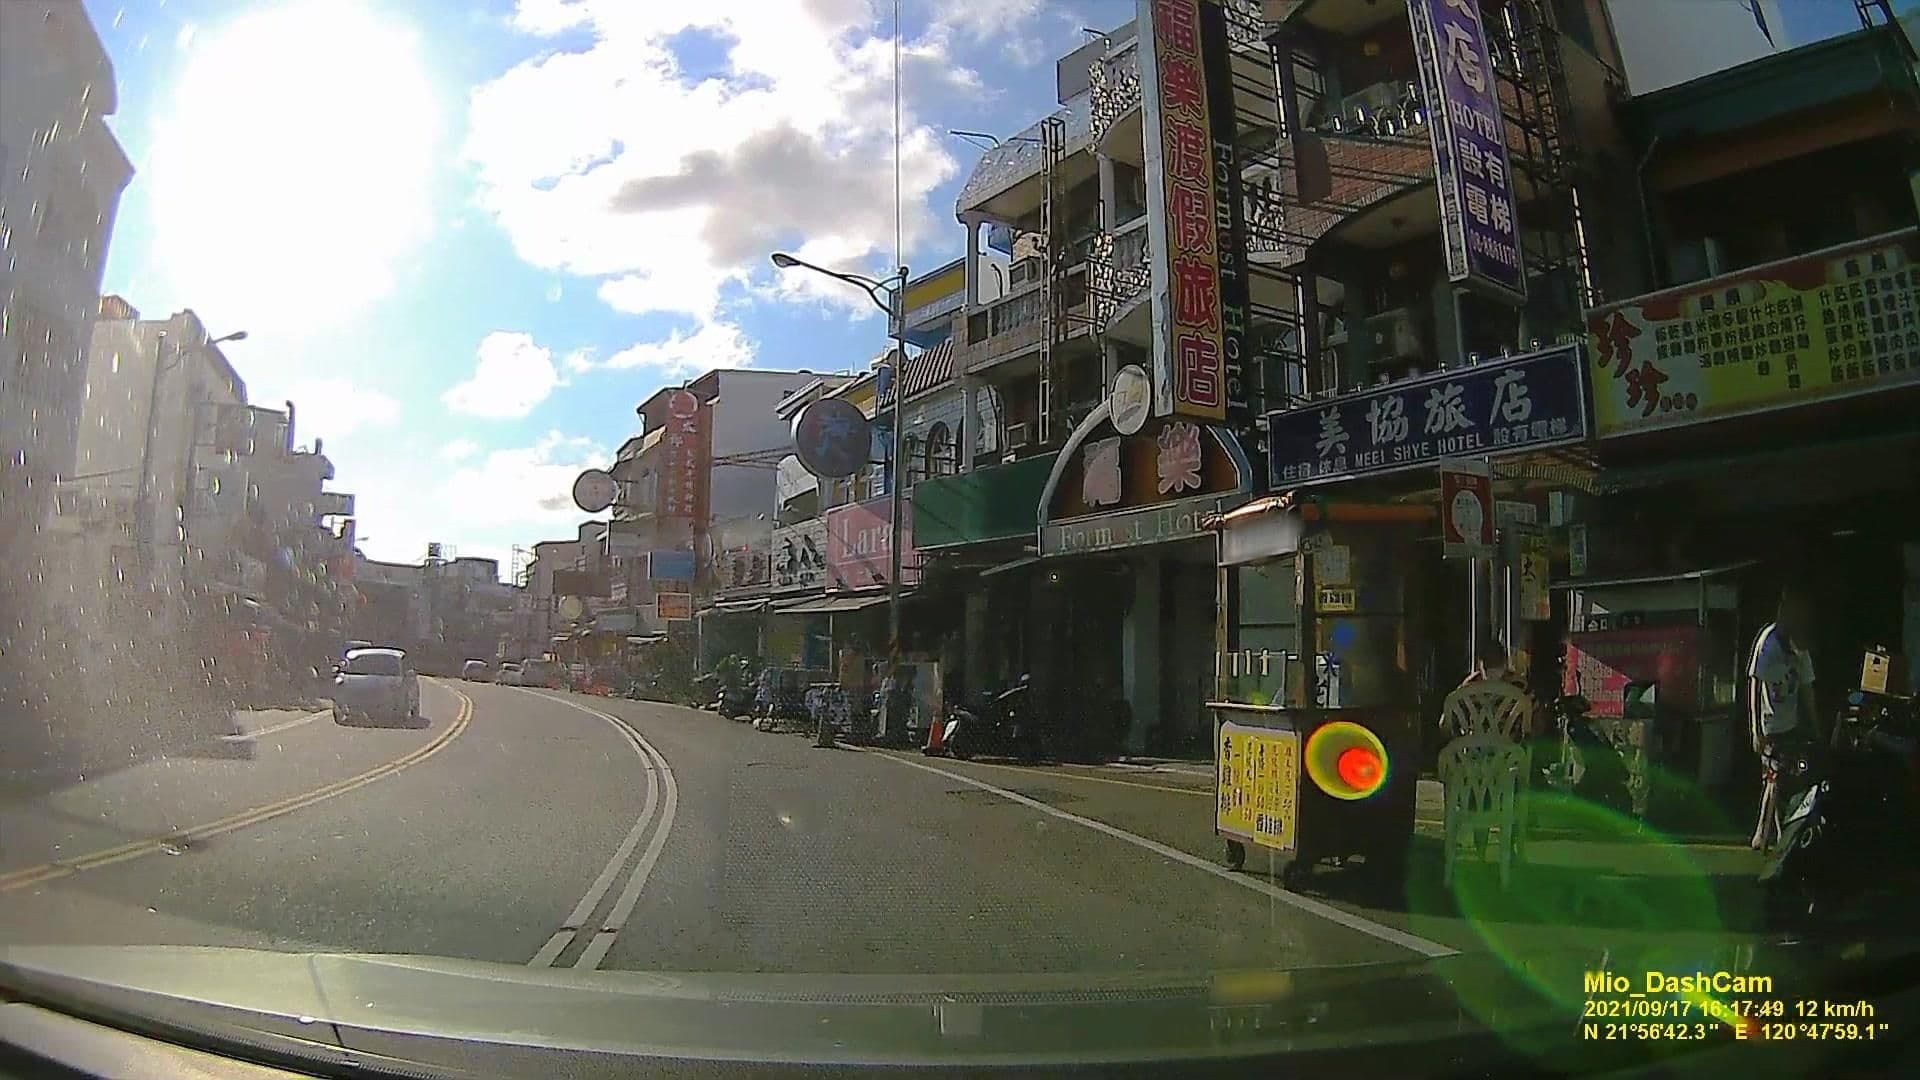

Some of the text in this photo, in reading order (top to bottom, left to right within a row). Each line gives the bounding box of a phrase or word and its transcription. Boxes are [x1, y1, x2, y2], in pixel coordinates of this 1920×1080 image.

[1445, 0, 1486, 94] 店
[1450, 98, 1501, 145] HOTEL
[1214, 138, 1248, 409] Formost Hotel
[1315, 368, 1533, 458] 美協旅店
[1354, 450, 1386, 468] MEEI
[1393, 441, 1430, 462] SHYE
[1437, 431, 1485, 454] HOTEL
